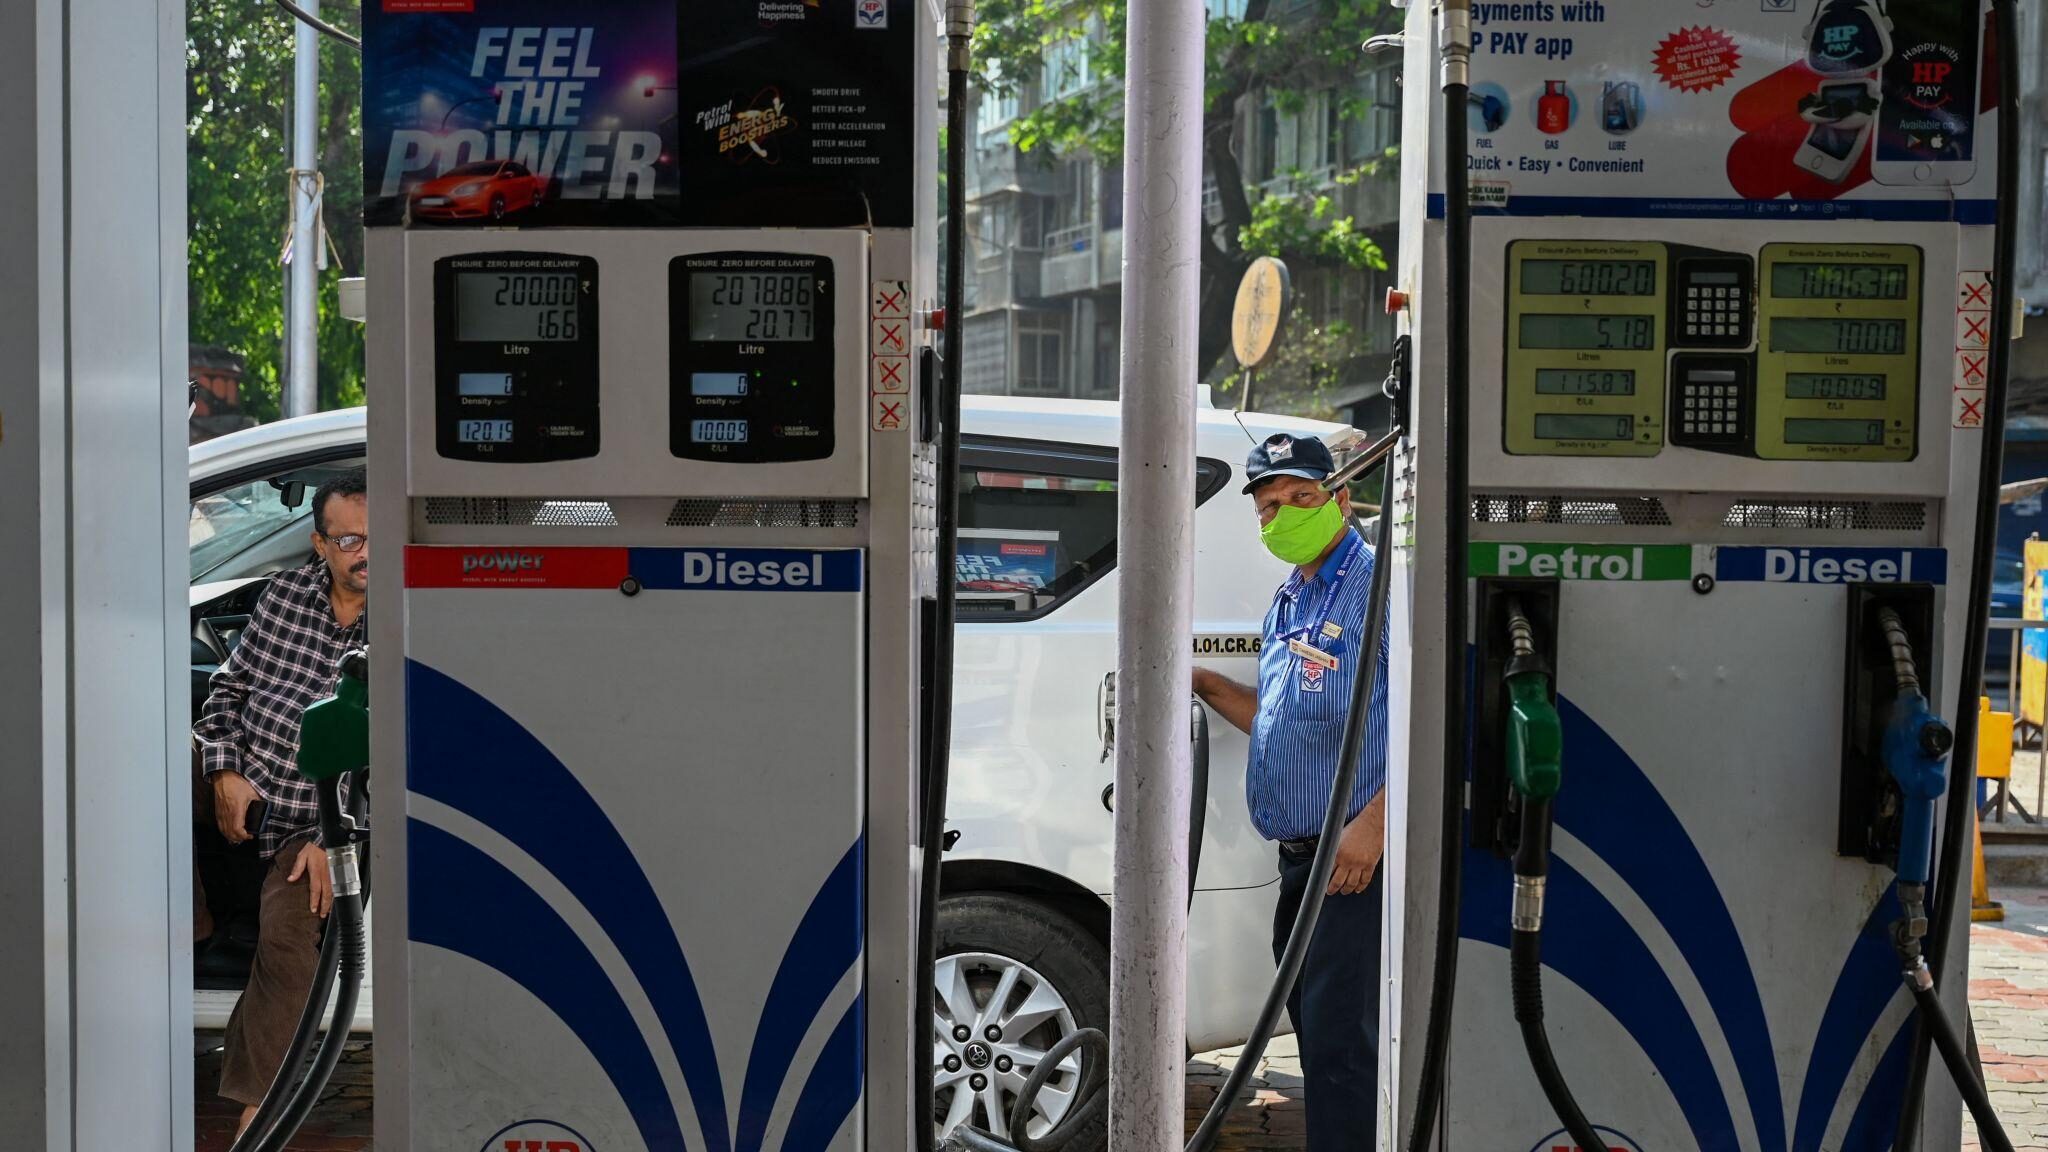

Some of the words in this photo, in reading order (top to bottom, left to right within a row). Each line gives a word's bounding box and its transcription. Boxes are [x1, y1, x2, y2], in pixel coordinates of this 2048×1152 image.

[759, 2, 804, 13] Delivering
[865, 2, 879, 11] HP
[1471, 1, 1554, 25] ayments
[1561, 0, 1605, 22] with
[758, 11, 805, 21] Happiness
[1824, 25, 1860, 43] HP
[470, 27, 601, 78] FEEL
[1471, 32, 1483, 53] P
[1490, 32, 1528, 54] PAY
[1535, 37, 1572, 60] app
[1827, 42, 1850, 53] PAY
[1902, 42, 1937, 60] Happy
[1939, 44, 1959, 62] with
[1912, 62, 1953, 84] HP
[811, 88, 839, 97] SMOOTH
[840, 88, 861, 97] DRIVE
[1916, 86, 1941, 97] PAY
[495, 81, 585, 125] THE
[696, 99, 733, 124] Petrol
[811, 105, 836, 113] BETTER
[838, 105, 867, 113] PICK-UP
[704, 112, 732, 131] With
[718, 101, 785, 142] ENERGY
[811, 122, 836, 131] BETTER
[838, 122, 886, 131] ACCELERATION
[1899, 119, 1940, 129] Available
[719, 115, 789, 153] BOOSTERS
[811, 140, 836, 148] BETTER
[838, 140, 867, 148] MILEAGE
[1476, 139, 1493, 148] FUEL
[1545, 140, 1559, 150] GAS
[1608, 141, 1626, 151] LUBE
[380, 129, 662, 200] POWER
[812, 157, 842, 165] REDUCED
[843, 157, 881, 165] EMISSIONS
[1467, 155, 1501, 170] Quick
[1519, 157, 1551, 174] Easy
[1569, 157, 1644, 173] Convenient
[495, 276, 577, 306] 200.00
[713, 276, 811, 306] 2078.86
[537, 310, 576, 340] 1.66
[746, 310, 811, 339] 20.77
[1597, 318, 1648, 348] 5.18
[504, 345, 530, 354] Litre
[739, 344, 765, 354] Litre
[1577, 352, 1600, 361] Litres
[1825, 356, 1848, 365] Litres
[738, 376, 747, 394] 0
[462, 397, 492, 406] Density
[696, 397, 727, 406] Density
[1617, 418, 1628, 438] 0
[1866, 423, 1878, 443] 0
[683, 552, 823, 586] Diesel
[1500, 545, 1643, 580] Petrol
[1764, 549, 1912, 583] Diesel
[1307, 671, 1319, 679] HP
